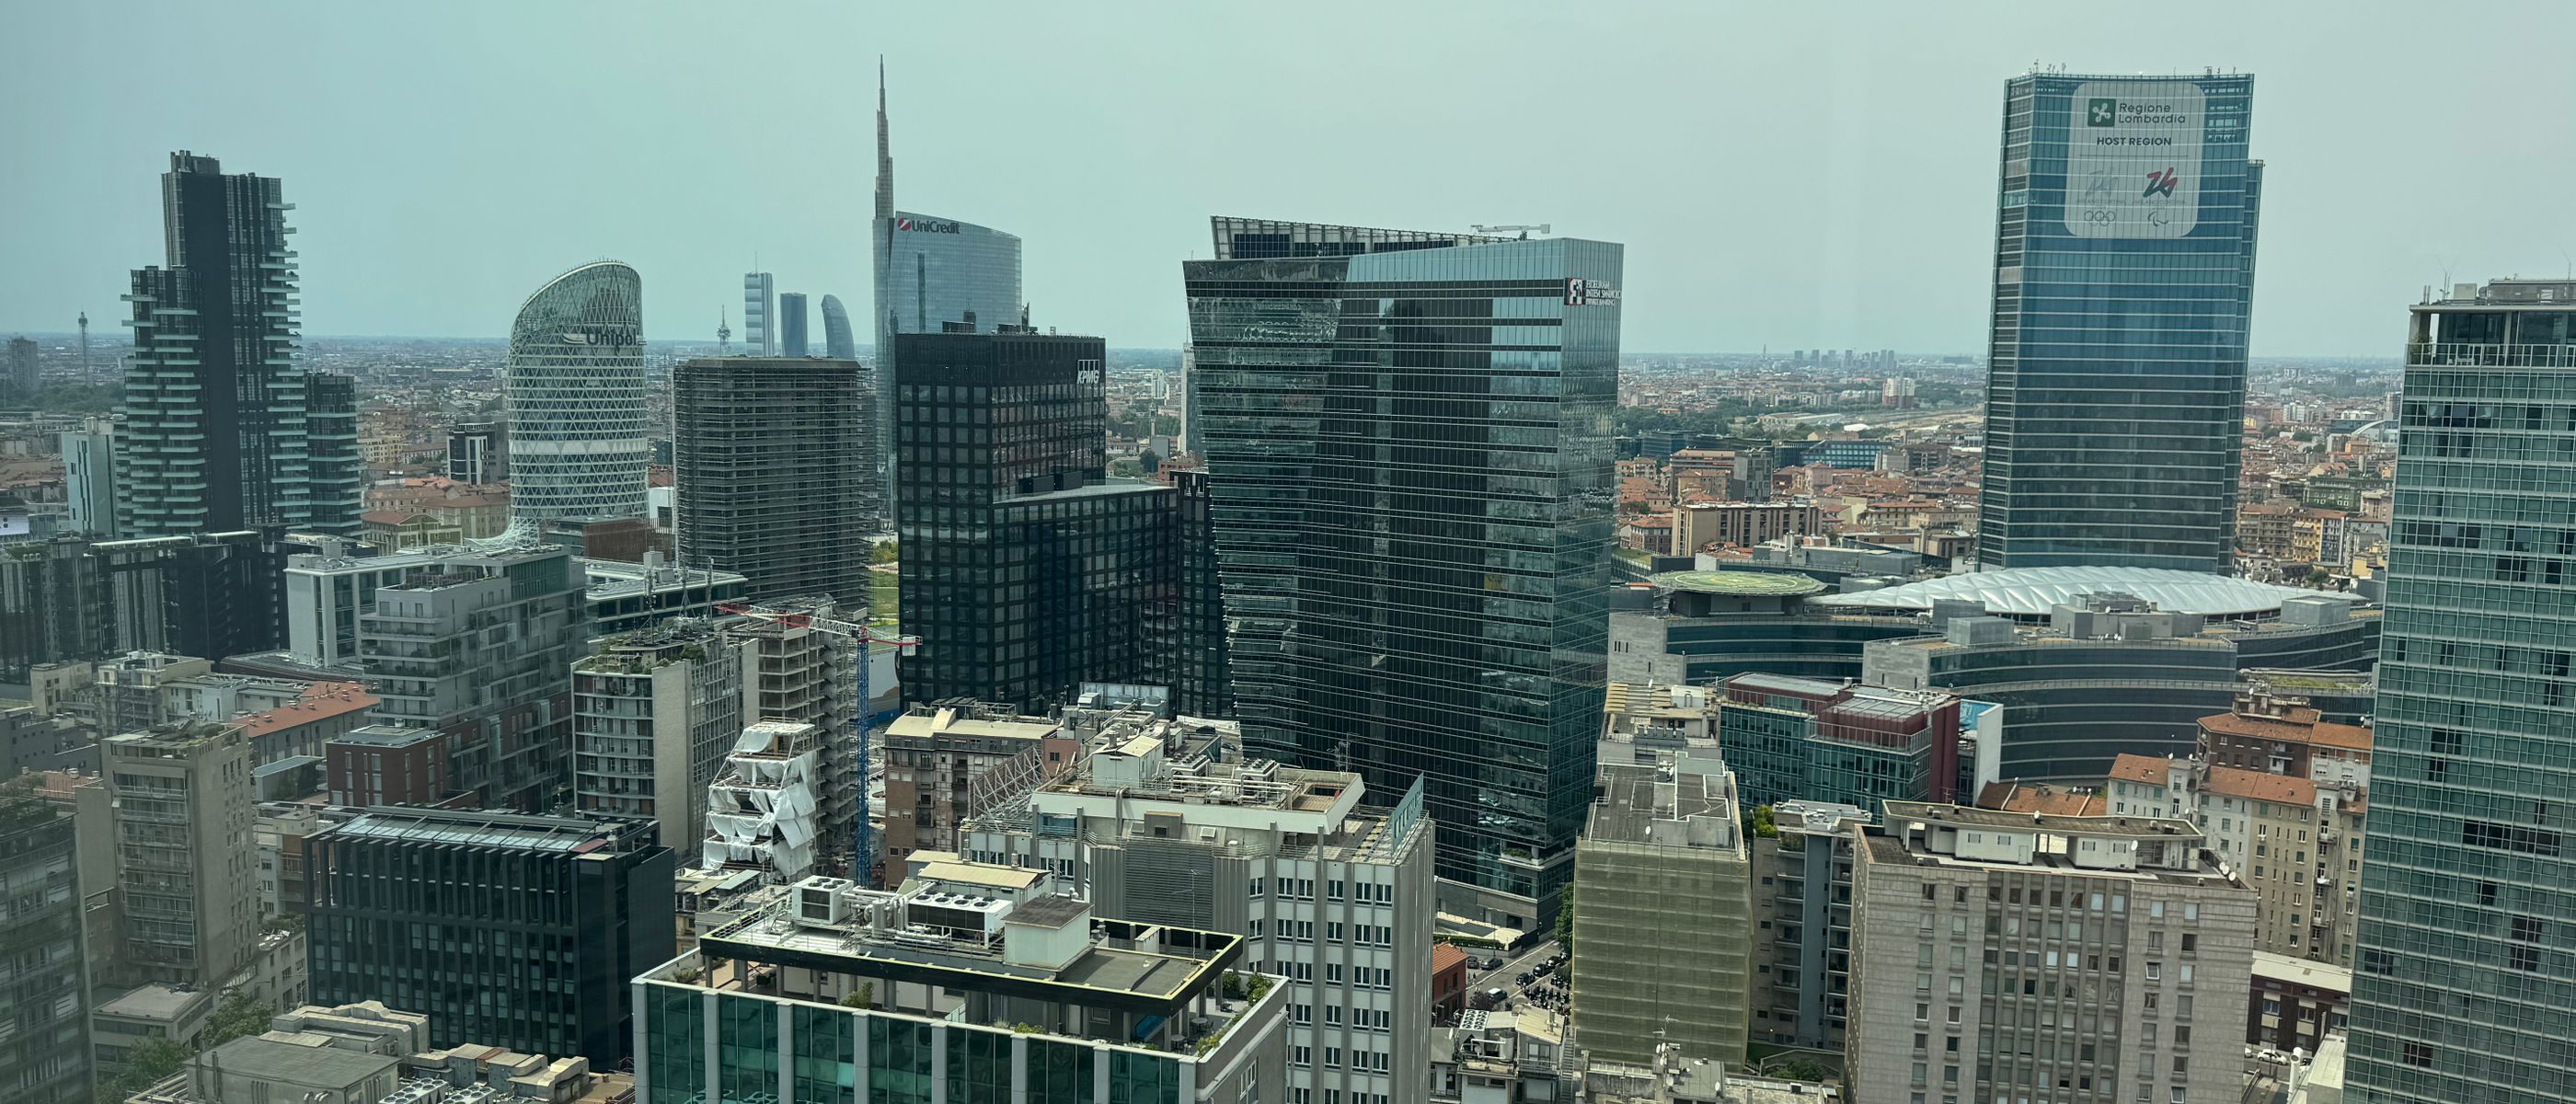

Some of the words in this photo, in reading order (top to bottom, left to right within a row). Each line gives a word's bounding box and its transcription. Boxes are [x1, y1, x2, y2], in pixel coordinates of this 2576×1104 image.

[2119, 103, 2171, 115] Regione
[2119, 114, 2186, 124] Lombardia
[2097, 137, 2126, 145] HOST
[2129, 137, 2172, 146] REGION
[912, 220, 960, 234] UniCredit
[586, 328, 637, 351] Unipol
[1077, 369, 1099, 384] KPMG
